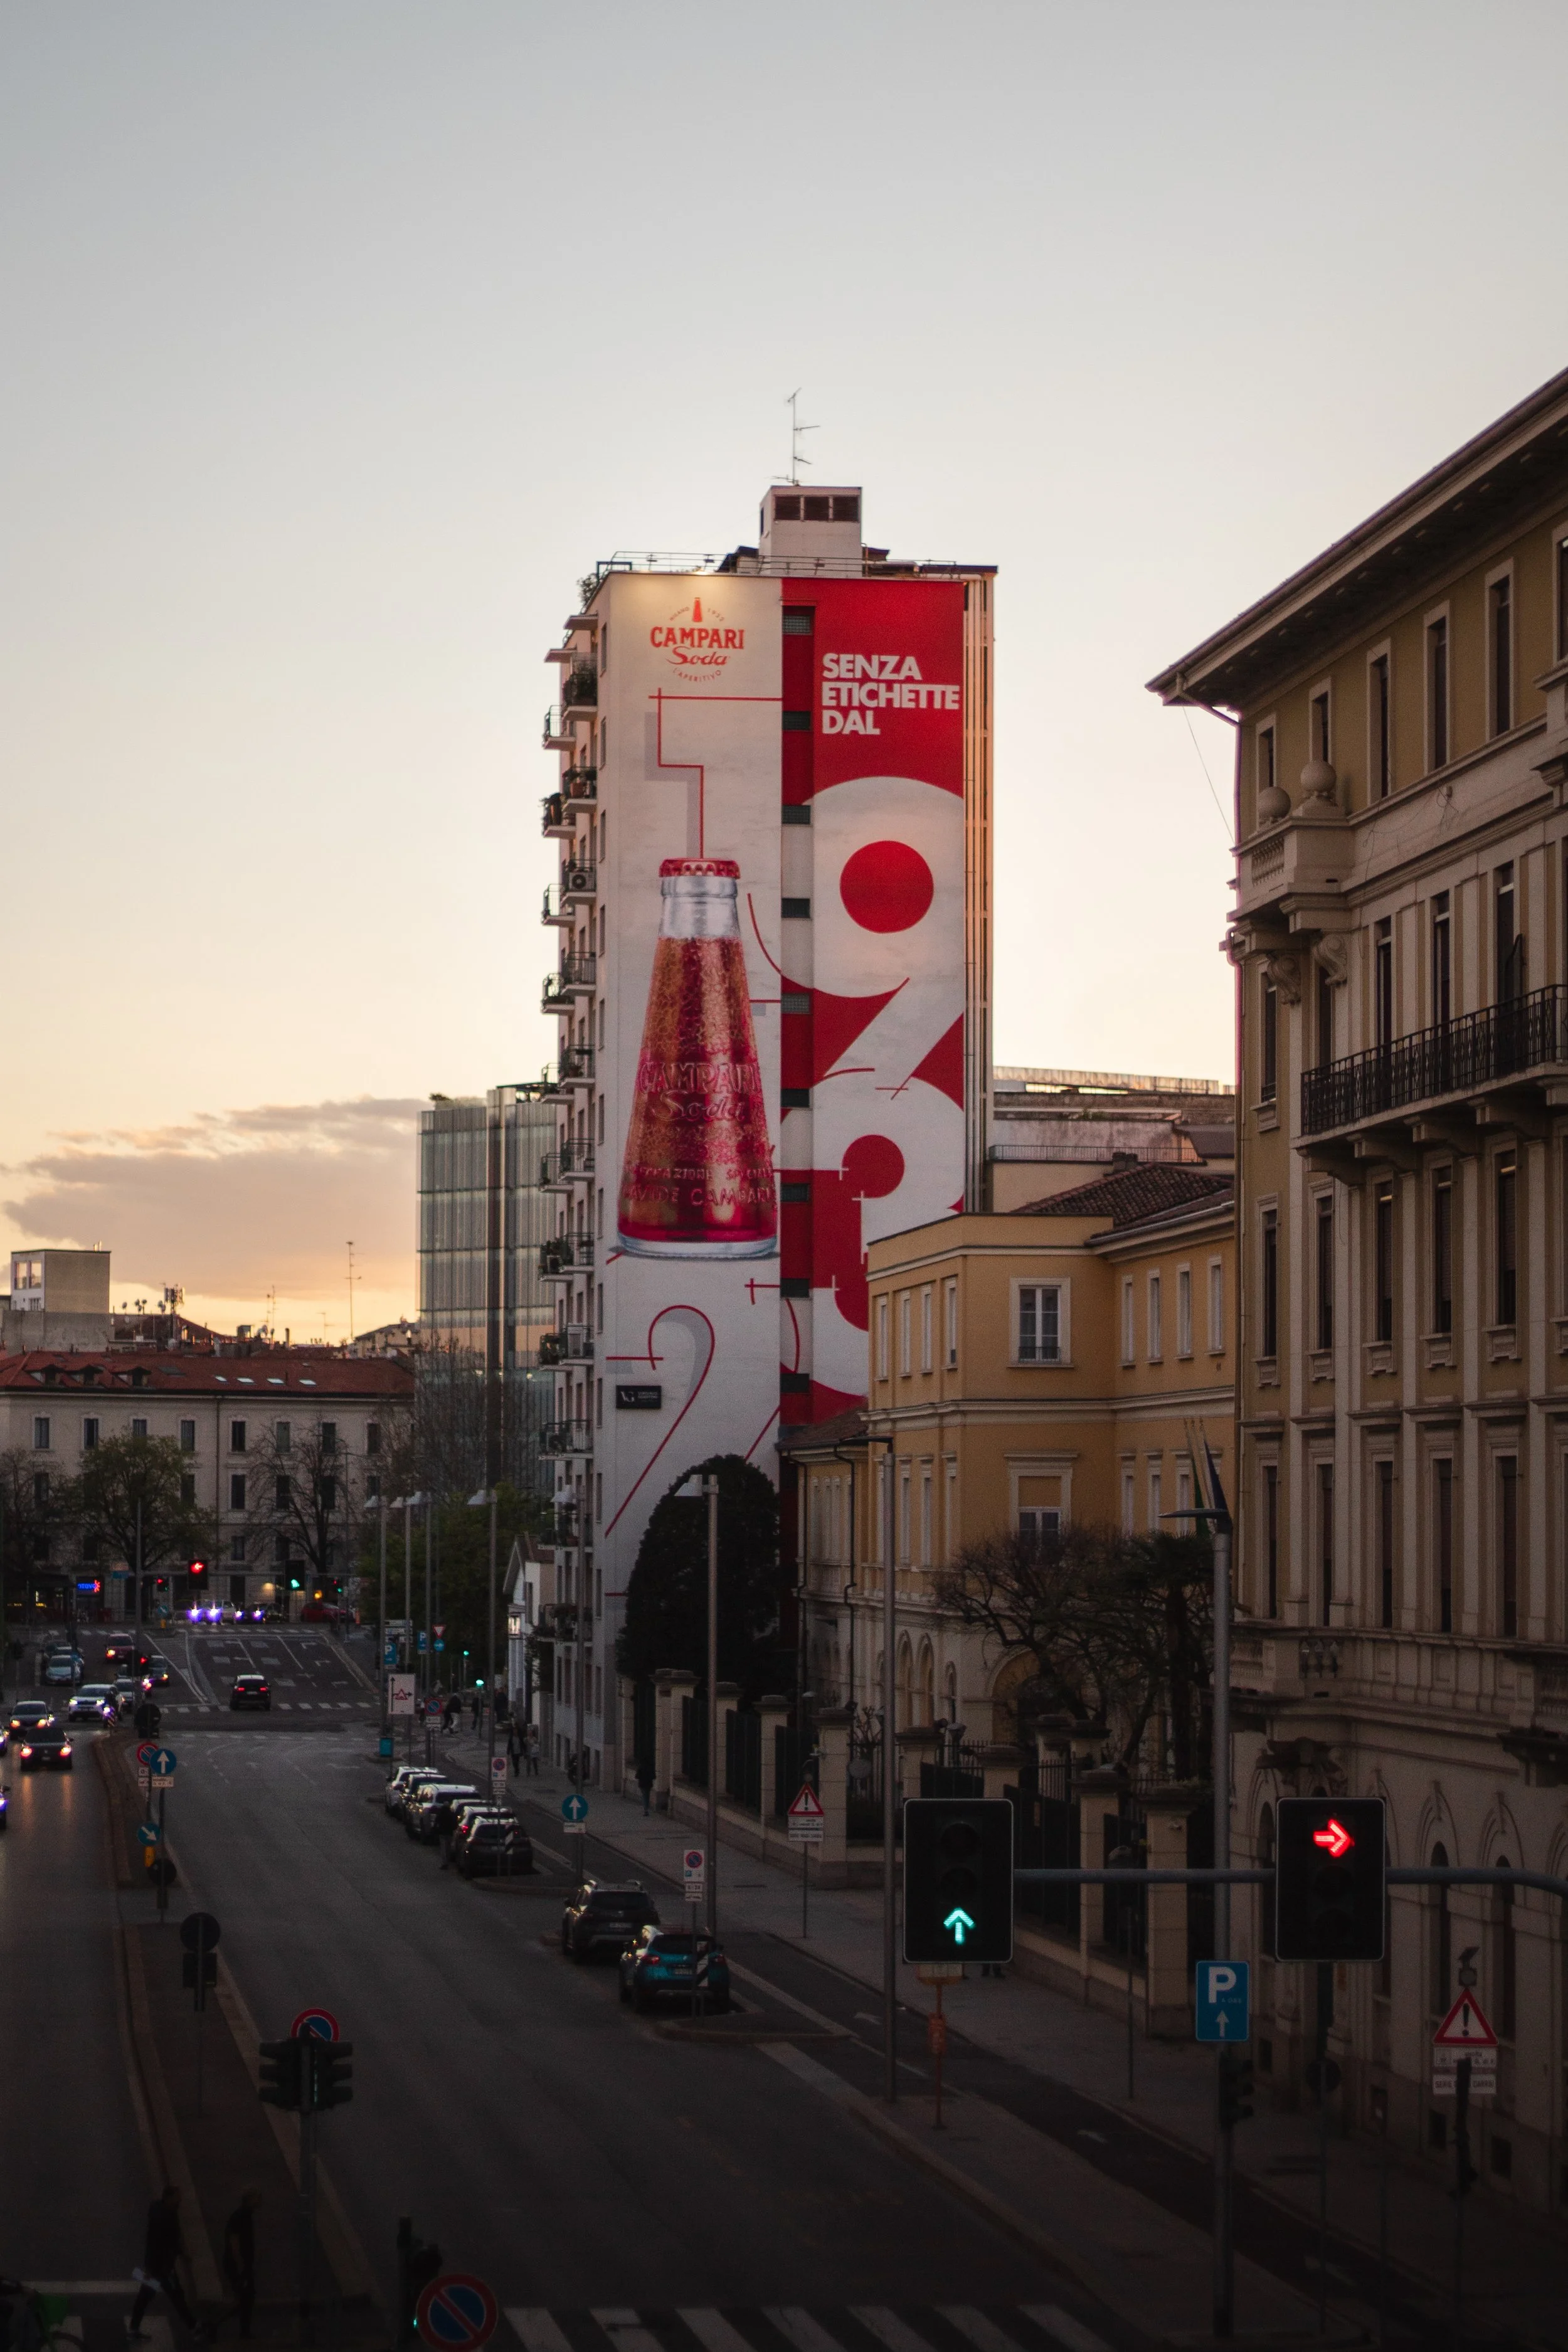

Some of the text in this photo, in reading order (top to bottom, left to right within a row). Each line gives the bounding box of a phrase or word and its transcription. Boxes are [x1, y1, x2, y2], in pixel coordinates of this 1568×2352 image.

[650, 627, 744, 649] CAMPARI
[666, 646, 730, 665] Soda
[822, 653, 923, 680] SENZA
[822, 681, 960, 709] ETICHETTE
[822, 709, 881, 735] DAL
[1209, 1966, 1237, 2003] P
